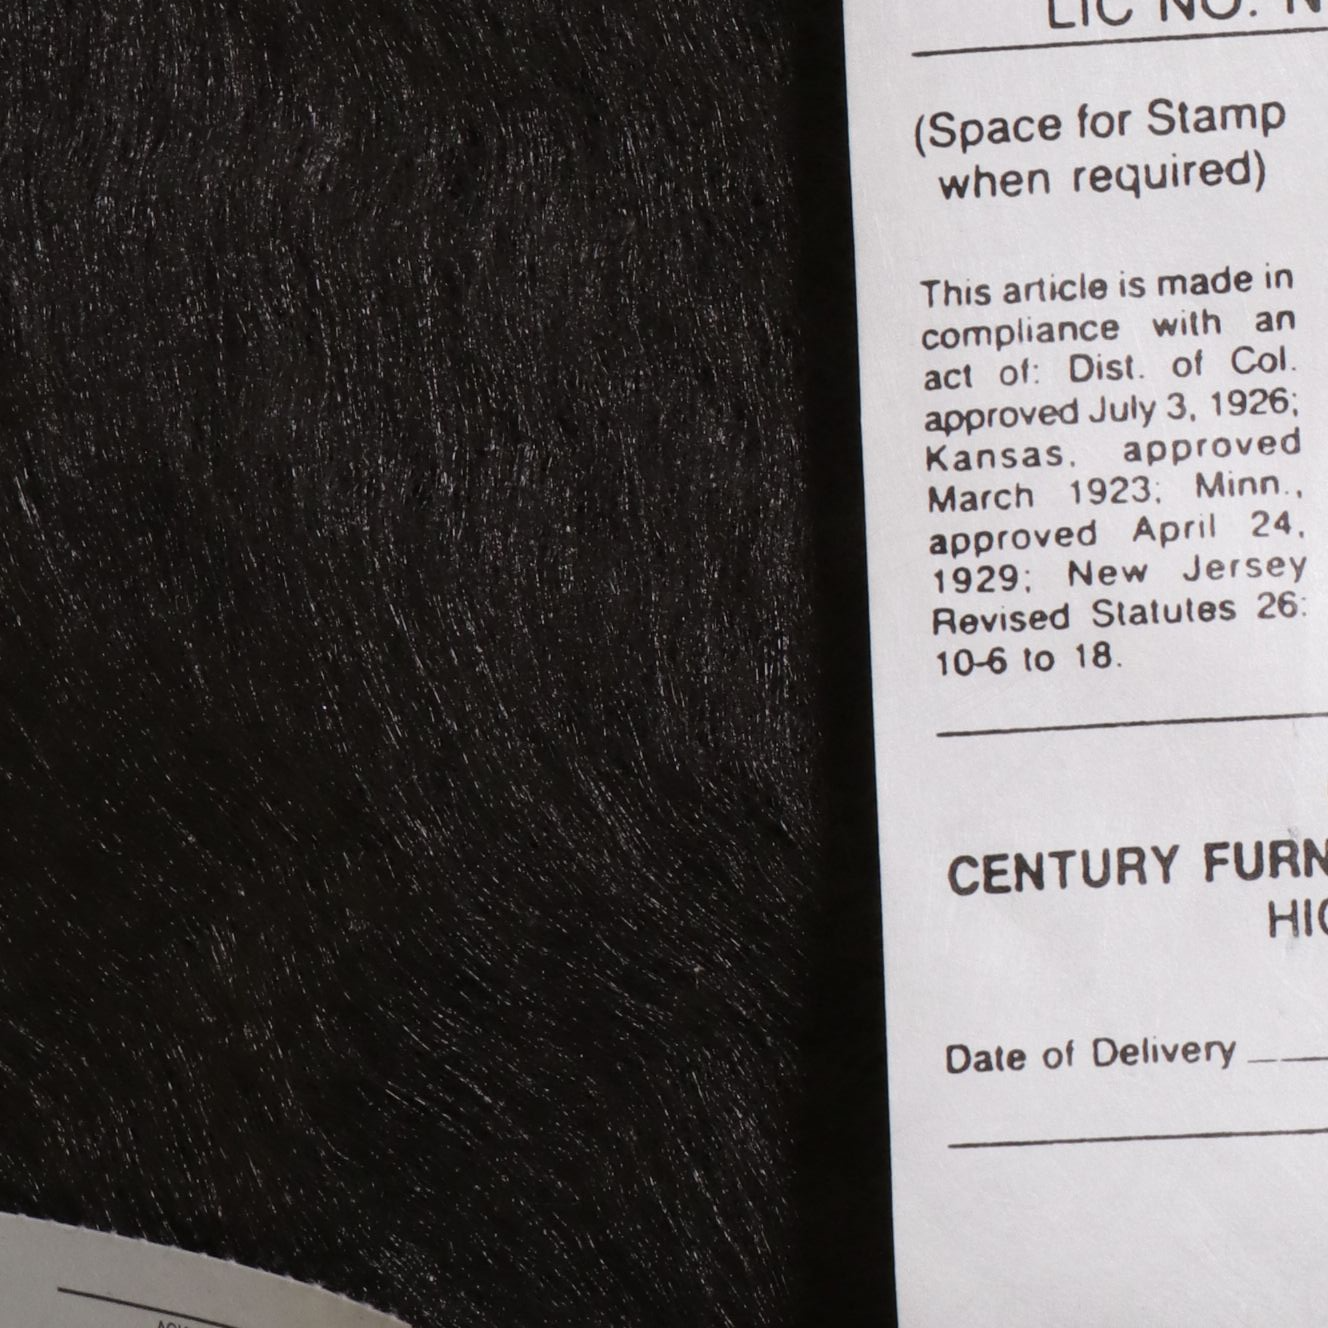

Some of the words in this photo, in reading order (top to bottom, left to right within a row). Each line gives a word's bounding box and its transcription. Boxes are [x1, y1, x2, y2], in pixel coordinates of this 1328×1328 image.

[915, 112, 1062, 158] (Space
[1078, 103, 1132, 138] for
[1148, 98, 1285, 137] Stamp
[938, 165, 1050, 200] when
[1074, 149, 1265, 199] required)
[920, 280, 991, 308] This
[1003, 273, 1107, 304] article
[1120, 271, 1145, 298] is
[1158, 266, 1253, 296] made
[1265, 263, 1293, 289] in
[922, 318, 1119, 351] compliance
[1153, 309, 1221, 337] with
[1256, 310, 1295, 332] an
[925, 364, 972, 391] act
[1000, 358, 1038, 386] of:
[1070, 354, 1143, 382] Dist.
[1173, 349, 1202, 377] of
[1231, 346, 1296, 374] Col.
[925, 398, 1078, 437] approved
[1089, 395, 1156, 428] July
[1168, 393, 1195, 421] 3,
[1212, 387, 1298, 416] 1926;
[1124, 427, 1300, 466] approved
[929, 483, 1033, 512] March
[930, 519, 1096, 559] approved
[1133, 514, 1215, 548] April
[934, 564, 1030, 593] 1929;
[1068, 560, 1147, 586] New
[1183, 555, 1306, 583] Jersey
[933, 603, 1069, 635] Revised
[1092, 598, 1236, 628] Statutes
[937, 647, 1007, 676] 10-6
[1024, 648, 1055, 672] to
[1076, 641, 1121, 669] 18.
[948, 845, 1179, 896] CENTURY
[946, 1044, 1026, 1074] Date
[1043, 1040, 1074, 1069] of
[1093, 1038, 1236, 1069] Delivery
